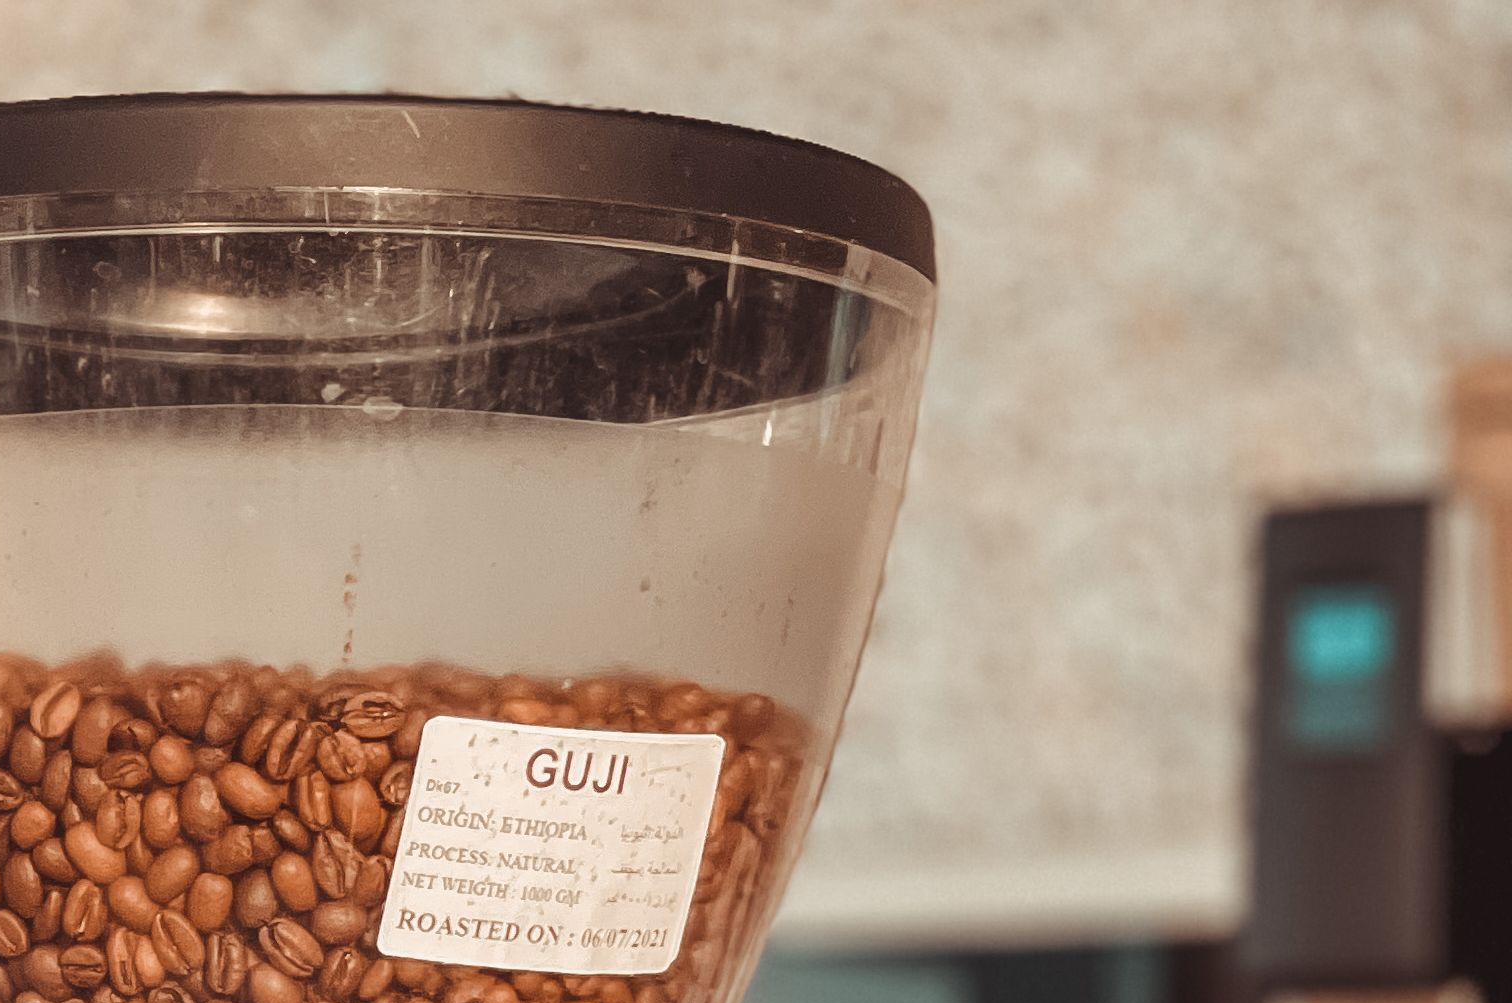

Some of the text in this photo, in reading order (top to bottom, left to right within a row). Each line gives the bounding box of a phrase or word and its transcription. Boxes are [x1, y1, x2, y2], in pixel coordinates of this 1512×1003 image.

[525, 747, 630, 795] GUJI
[499, 815, 588, 841] ETHIOPIA
[496, 852, 578, 875] NATURAL
[400, 871, 438, 890] NET
[441, 876, 510, 900] WEIGTH
[520, 885, 553, 902] 1000
[555, 888, 583, 906] GM
[395, 908, 521, 943] ROASTED
[526, 923, 565, 947] ON
[580, 927, 670, 949] 06/07/2021
